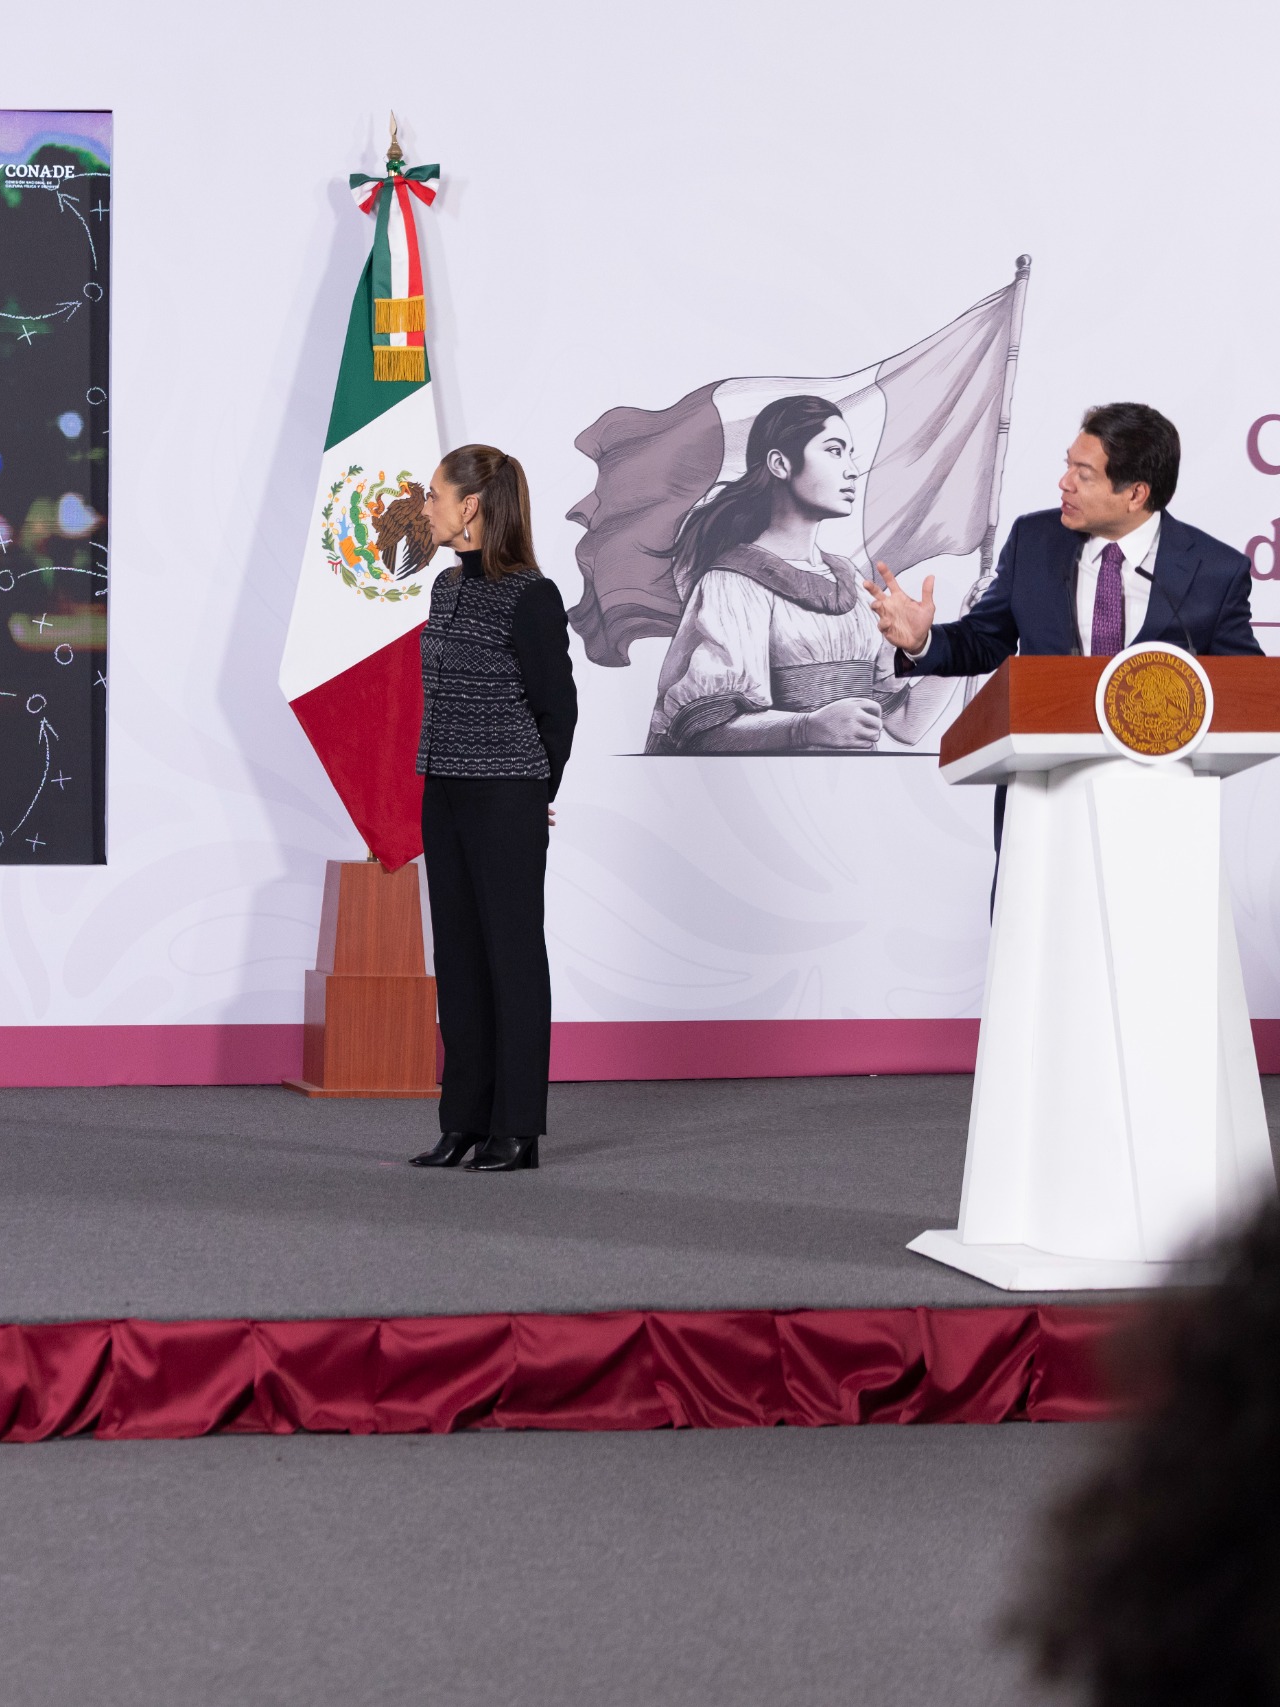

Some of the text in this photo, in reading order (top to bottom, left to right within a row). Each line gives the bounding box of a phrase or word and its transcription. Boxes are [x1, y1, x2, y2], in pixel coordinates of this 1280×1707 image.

[4, 164, 75, 179] CONADE
[1106, 653, 1204, 704] ESTADOS UNIDOS MEXICANOS
